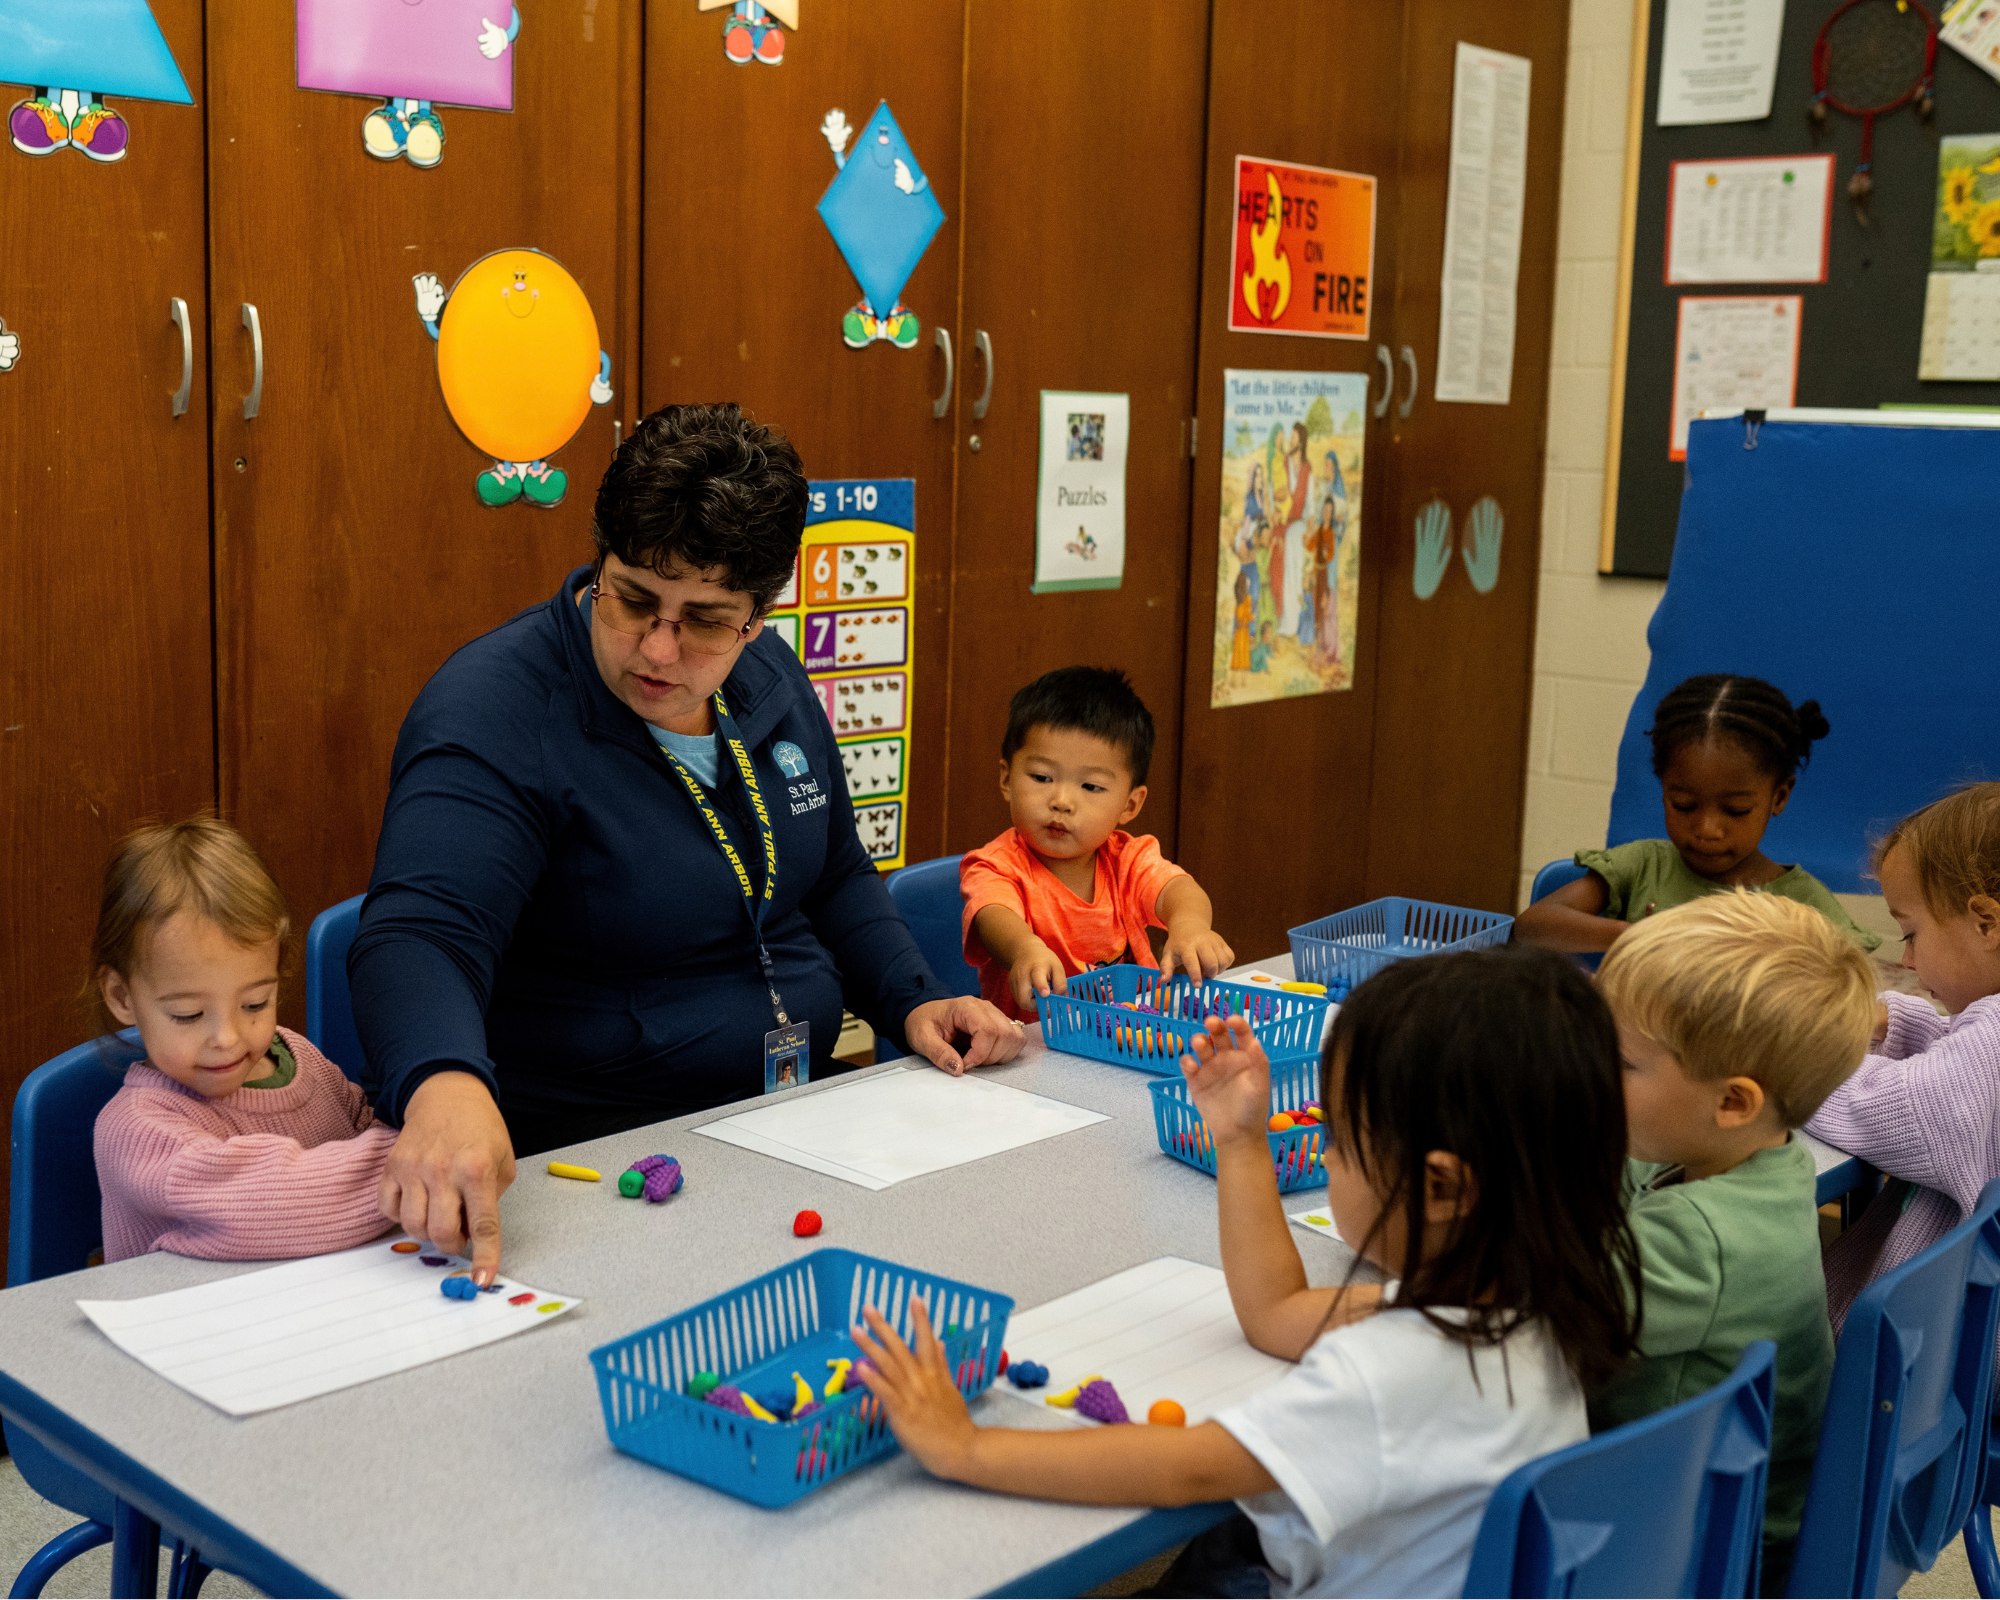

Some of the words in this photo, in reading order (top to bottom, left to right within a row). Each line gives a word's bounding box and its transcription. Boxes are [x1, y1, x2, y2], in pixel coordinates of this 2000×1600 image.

[1239, 191, 1319, 231] HEARTS
[1304, 239, 1324, 263] ON
[1313, 272, 1366, 315] FIRE
[1253, 380, 1269, 396] the
[1272, 380, 1296, 396] little
[1299, 380, 1341, 396] children
[1234, 403, 1261, 416] come
[1263, 402, 1274, 416] to
[836, 485, 878, 512] 1-10
[1057, 484, 1108, 507] Puzzles
[813, 549, 832, 584] 6
[815, 587, 829, 600] six
[812, 616, 831, 653] 7
[805, 656, 834, 670] seven
[729, 739, 760, 791] ARBOR
[788, 786, 802, 799] St.
[799, 778, 820, 796] Paul
[749, 791, 770, 827] ANN
[790, 802, 809, 816] Ann
[807, 793, 827, 811] Arbor
[659, 745, 678, 763] ST
[675, 766, 706, 805] PAUL
[701, 807, 728, 841] ANN
[721, 843, 754, 897] ARBOR
[763, 830, 777, 876] PAUL
[764, 877, 776, 901] ST
